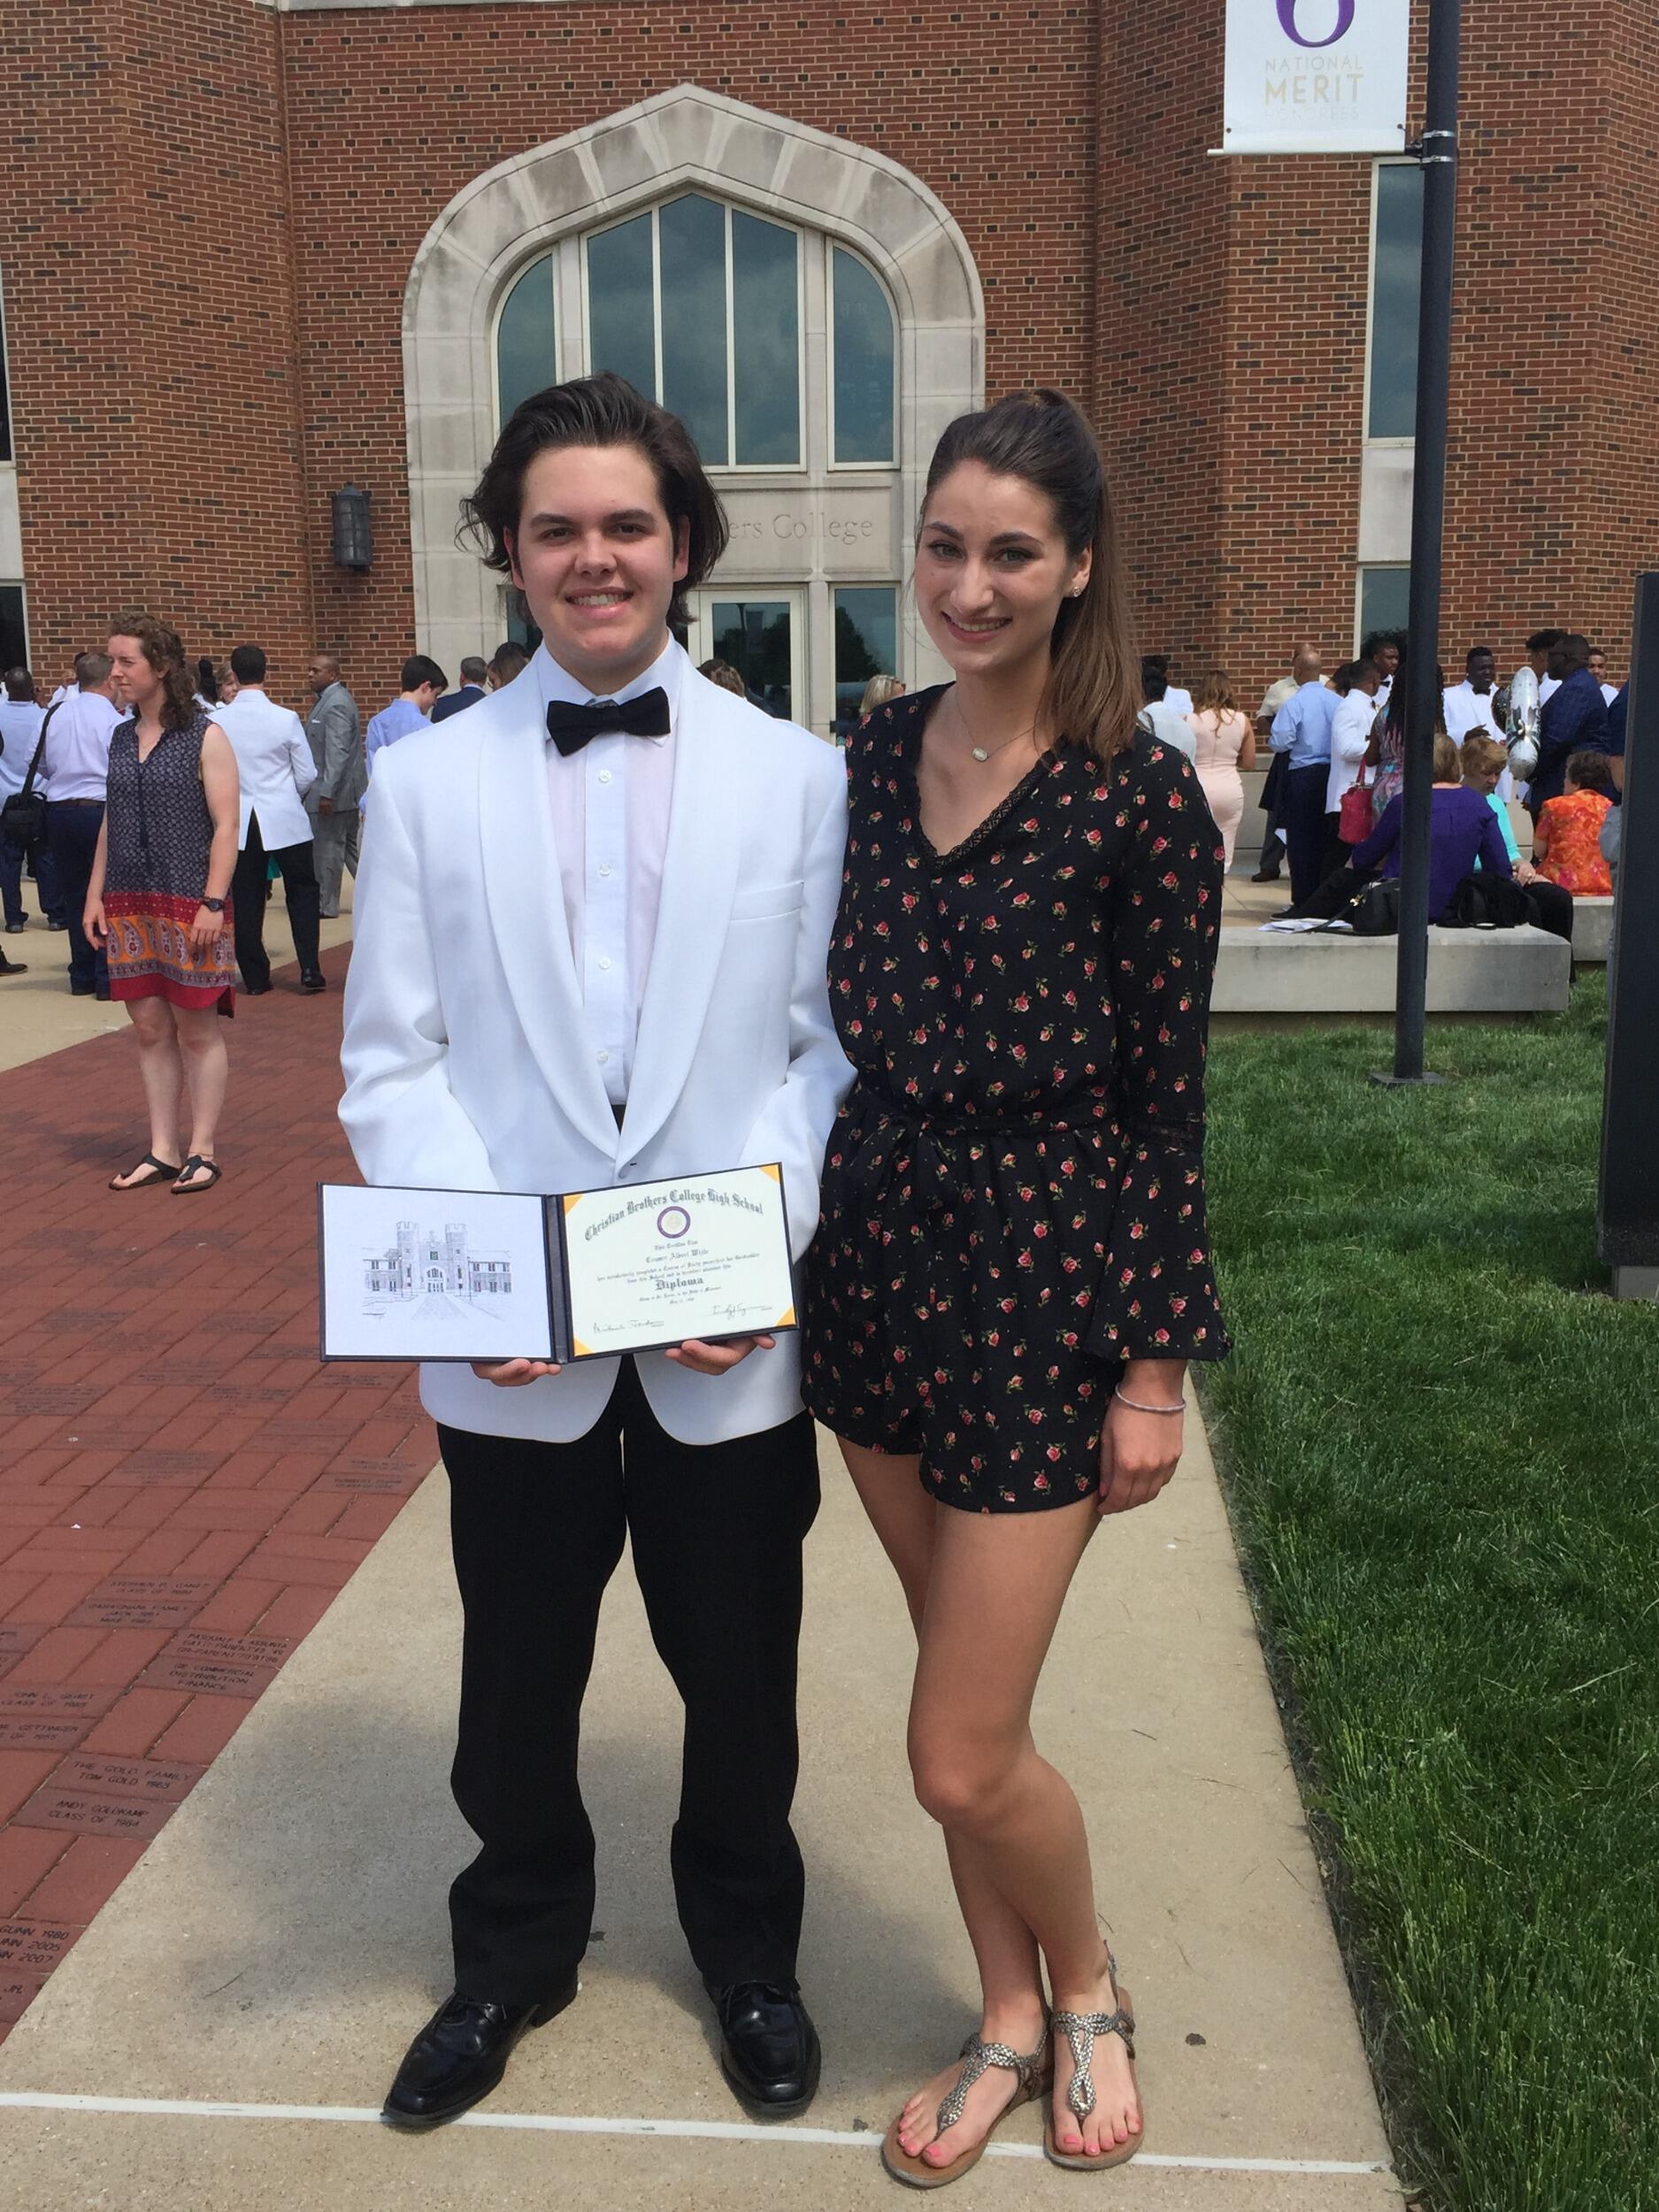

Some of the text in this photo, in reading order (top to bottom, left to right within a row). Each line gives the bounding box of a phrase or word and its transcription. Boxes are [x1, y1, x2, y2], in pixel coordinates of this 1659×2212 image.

[1265, 56, 1363, 73] NATIONAL
[1264, 73, 1363, 105] MERIT
[773, 511, 872, 545] College
[584, 1187, 764, 1241] Christian Brothers College High School
[655, 1278, 703, 1291] Diploma
[169, 1671, 250, 1685] DISTRIBUTION
[194, 1665, 255, 1678] COMMERCIAL
[177, 1680, 227, 1691] FINANCE
[73, 1761, 192, 1781] THE GOLD FAMILY
[79, 1771, 102, 1781] TOM
[108, 1775, 138, 1786] GOLD
[56, 1800, 86, 1810] ANDY
[49, 1810, 86, 1821] CLASS
[90, 1815, 108, 1824] OF
[42, 1930, 70, 1940] 1980
[28, 1940, 61, 1952] 2005
[19, 1952, 54, 1963] 2007
